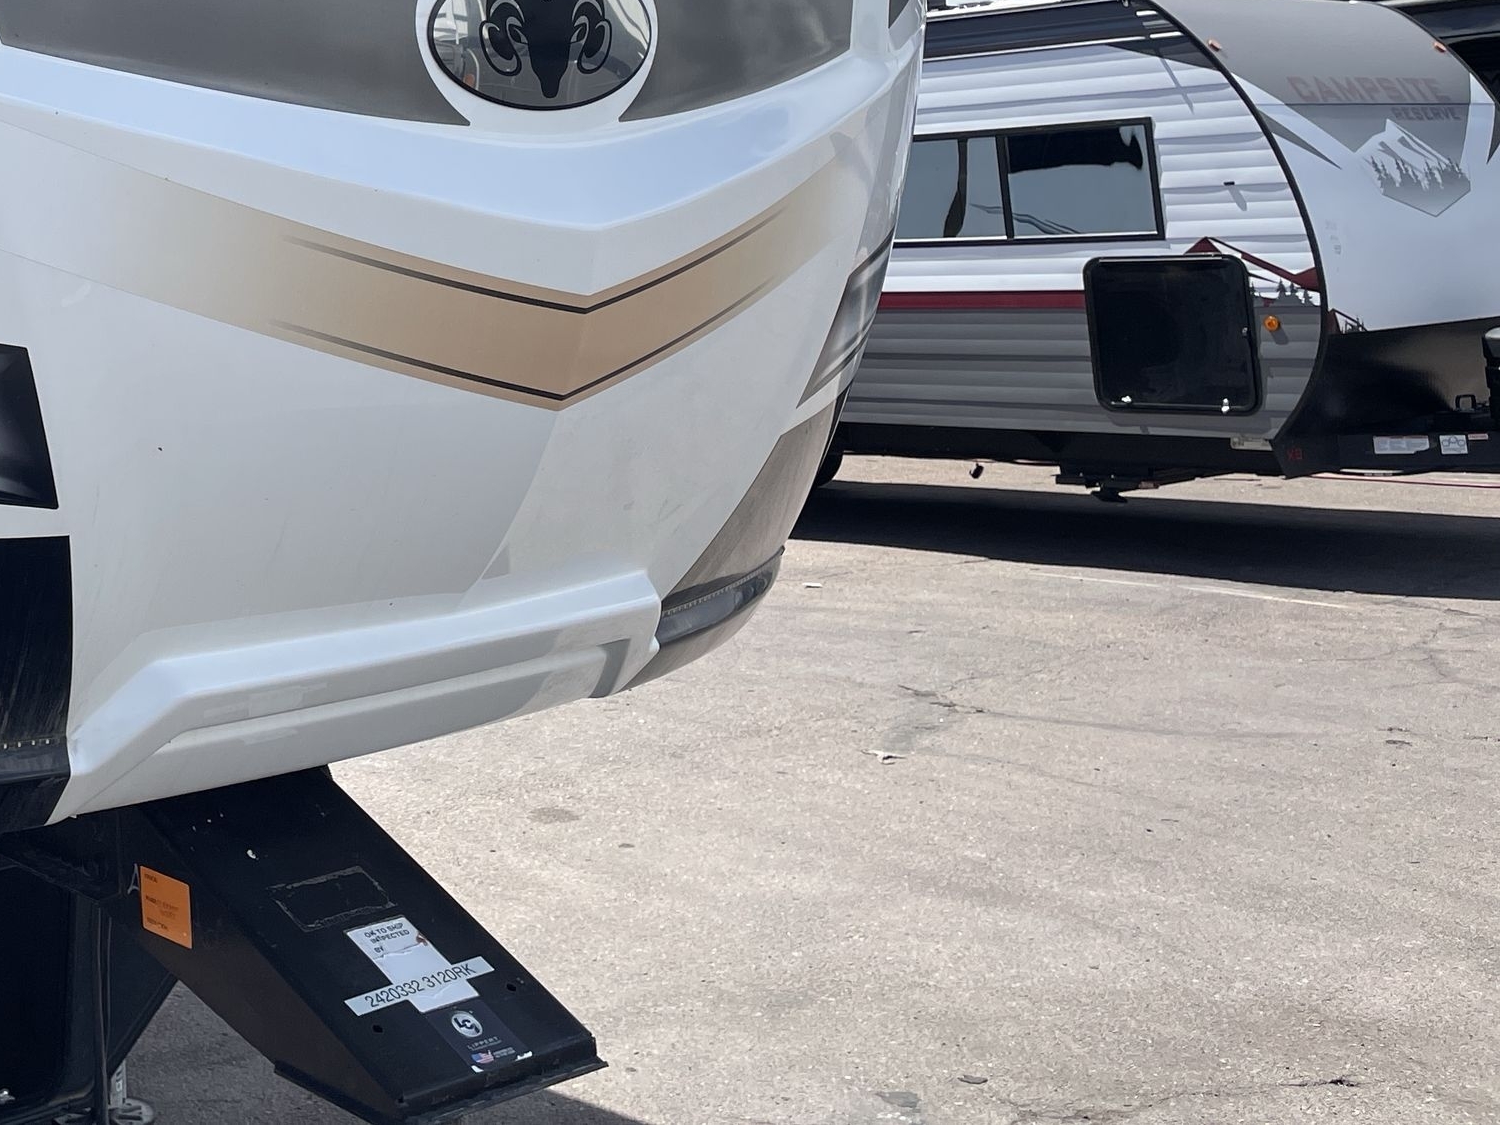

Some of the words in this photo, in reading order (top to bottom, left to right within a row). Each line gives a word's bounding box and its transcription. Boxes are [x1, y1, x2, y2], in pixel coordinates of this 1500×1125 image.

[1286, 76, 1451, 103] CAMPSITE
[1390, 107, 1463, 121] RESERVE
[364, 930, 377, 938] OK
[376, 928, 388, 936] TO
[387, 922, 404, 932] SHIP
[370, 929, 410, 944] INSPECTED
[374, 945, 385, 954] BY
[365, 980, 424, 1008] 2420332
[422, 963, 476, 988] 3120RK
